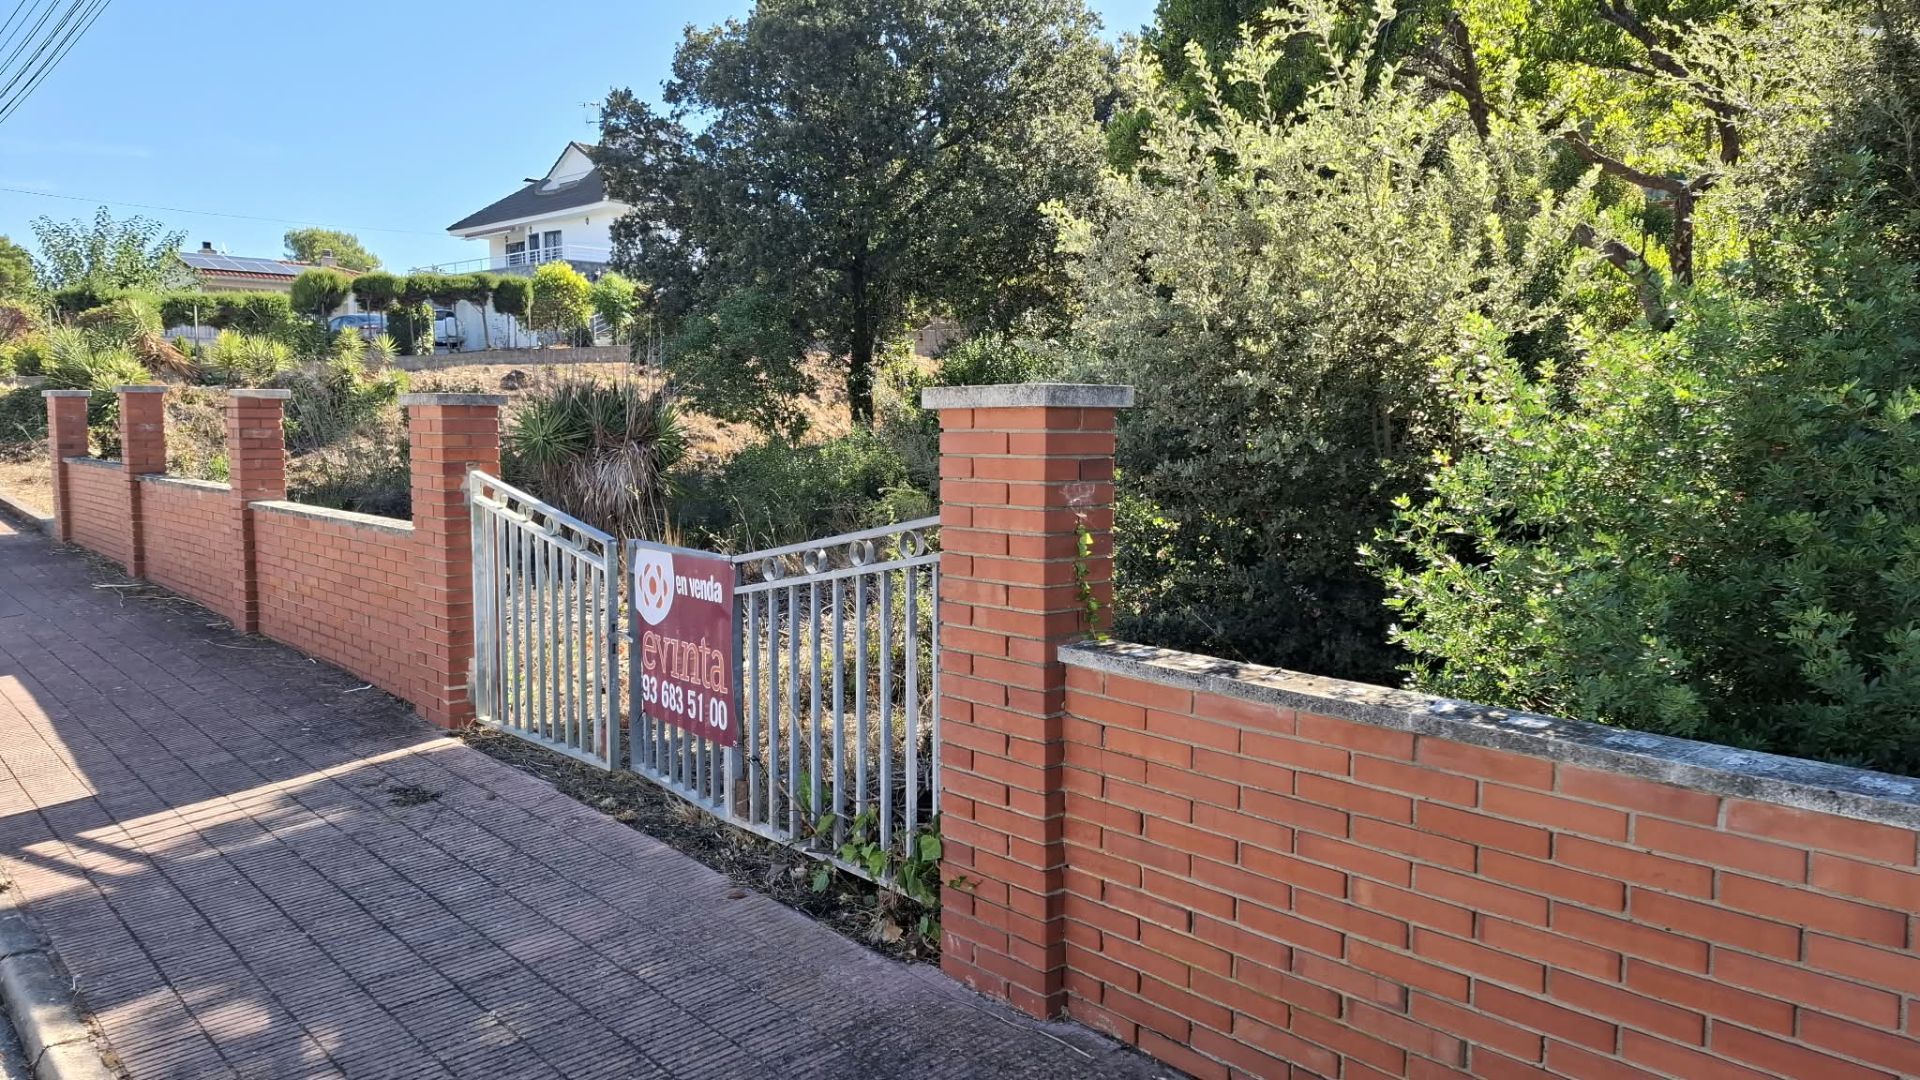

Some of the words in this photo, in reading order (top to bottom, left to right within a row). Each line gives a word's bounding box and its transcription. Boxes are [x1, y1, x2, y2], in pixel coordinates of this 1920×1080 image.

[675, 575, 688, 596] en
[689, 574, 723, 604] venda
[642, 630, 728, 694] evinta
[642, 674, 658, 704] 93
[661, 680, 684, 715] 683
[687, 689, 703, 722] 51
[709, 697, 728, 731] 00
